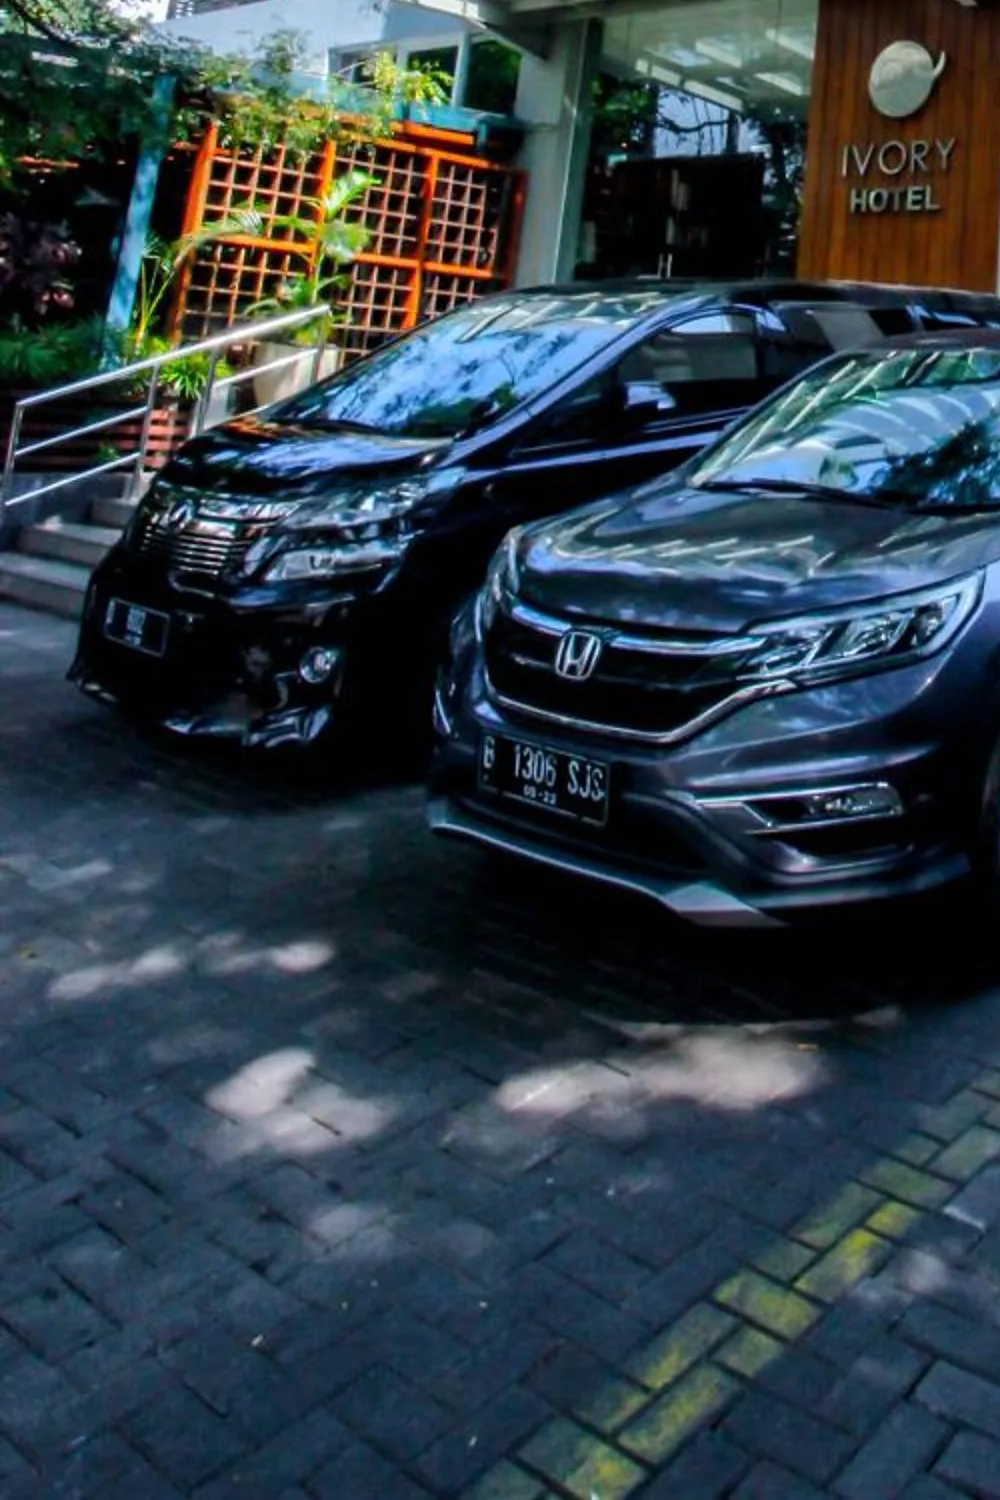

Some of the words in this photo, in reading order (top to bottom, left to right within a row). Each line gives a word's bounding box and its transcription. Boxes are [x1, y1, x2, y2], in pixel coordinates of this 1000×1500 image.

[841, 138, 956, 177] IVORY
[850, 185, 941, 214] HOTEL
[514, 743, 557, 787] 1306
[567, 760, 605, 801] SJS
